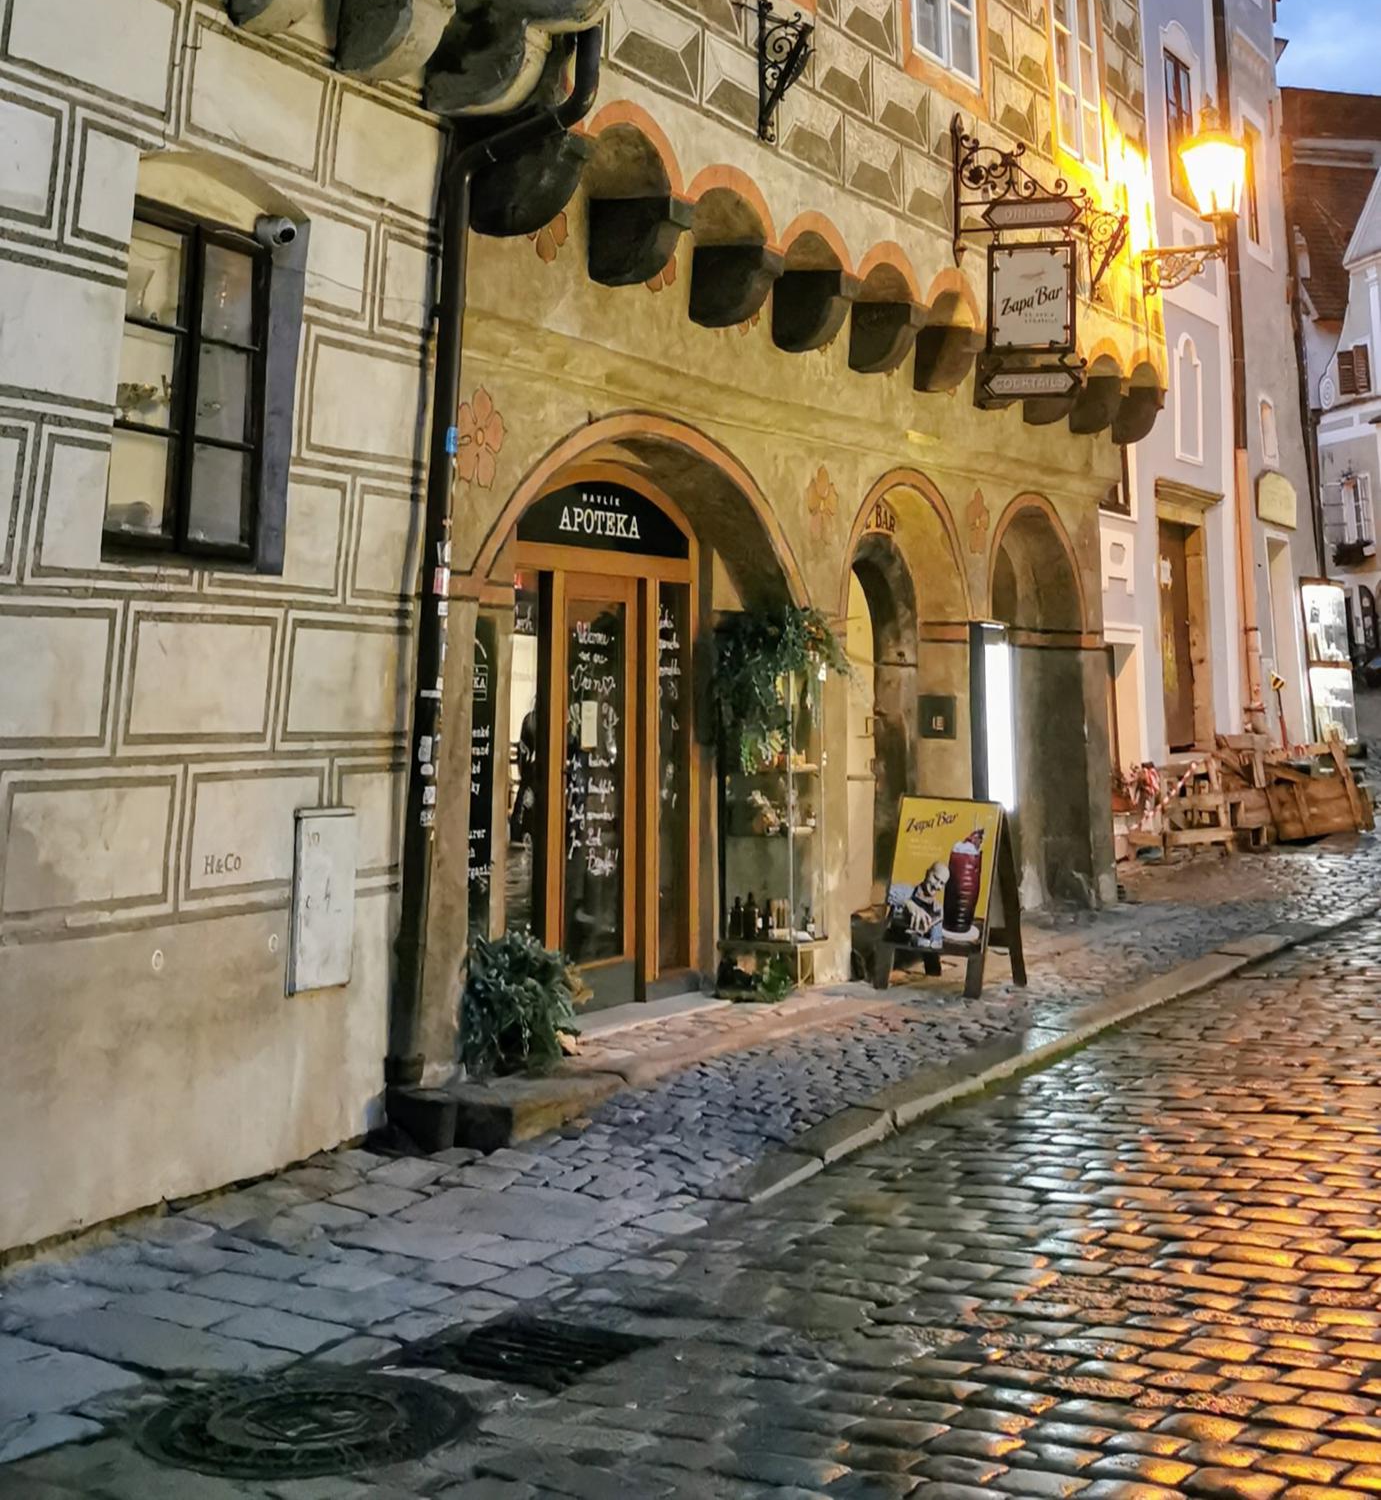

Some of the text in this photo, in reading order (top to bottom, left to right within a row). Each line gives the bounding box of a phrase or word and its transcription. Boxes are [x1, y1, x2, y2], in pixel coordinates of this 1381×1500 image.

[1000, 285, 1063, 317] Zapa Bar
[558, 505, 641, 539] APOTEKA
[875, 504, 896, 533] BAR
[905, 811, 959, 834] Zapa Bar
[204, 853, 242, 876] H&Co
